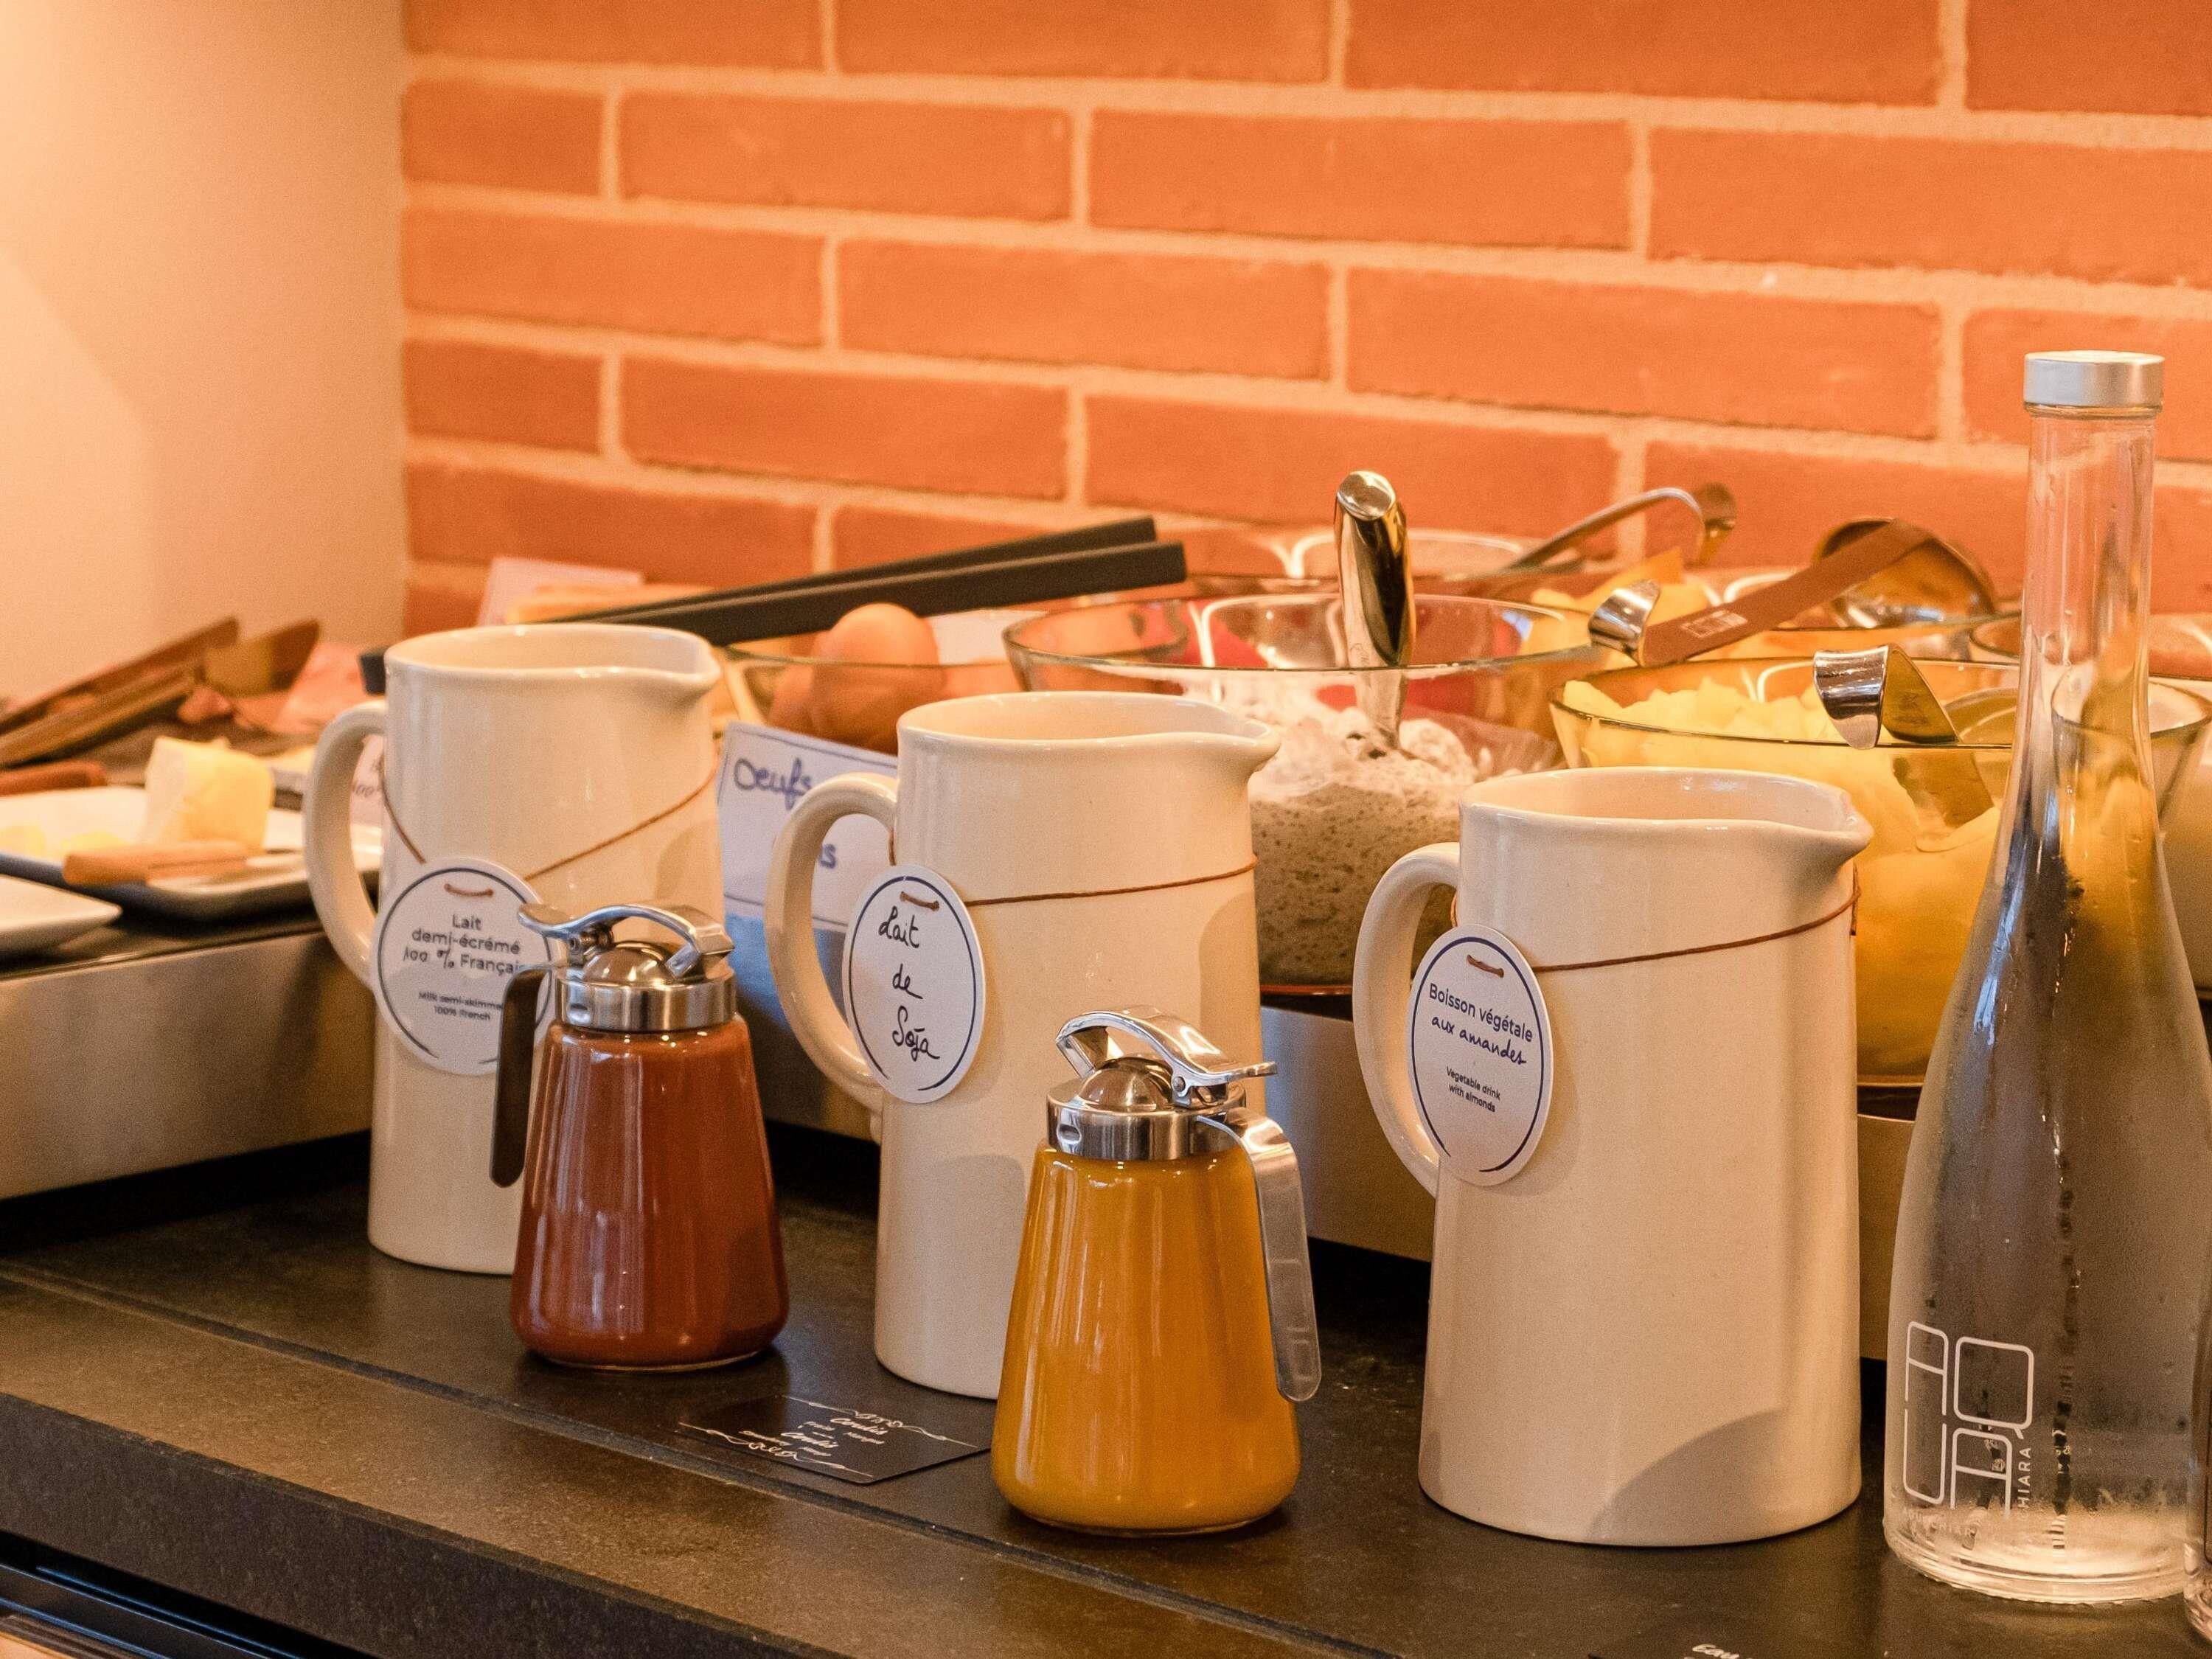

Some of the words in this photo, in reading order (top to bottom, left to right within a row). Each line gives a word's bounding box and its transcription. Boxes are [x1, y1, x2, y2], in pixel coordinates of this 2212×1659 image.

[452, 914, 481, 931] Lait
[879, 905, 919, 949] Lait
[411, 928, 521, 955] demi-écrémé
[460, 953, 521, 977] Françai
[892, 963, 924, 1000] de
[439, 995, 504, 1010] semi-skimme
[1430, 983, 1476, 1018] Boisson
[1479, 1008, 1533, 1043] végétale
[1432, 1017, 1455, 1035] aux
[1460, 1029, 1527, 1065] amandes
[1447, 1065, 1481, 1091] Vegetable
[1482, 1084, 1501, 1102] drink
[1448, 1082, 1464, 1098] with
[1465, 1091, 1496, 1113] almonds
